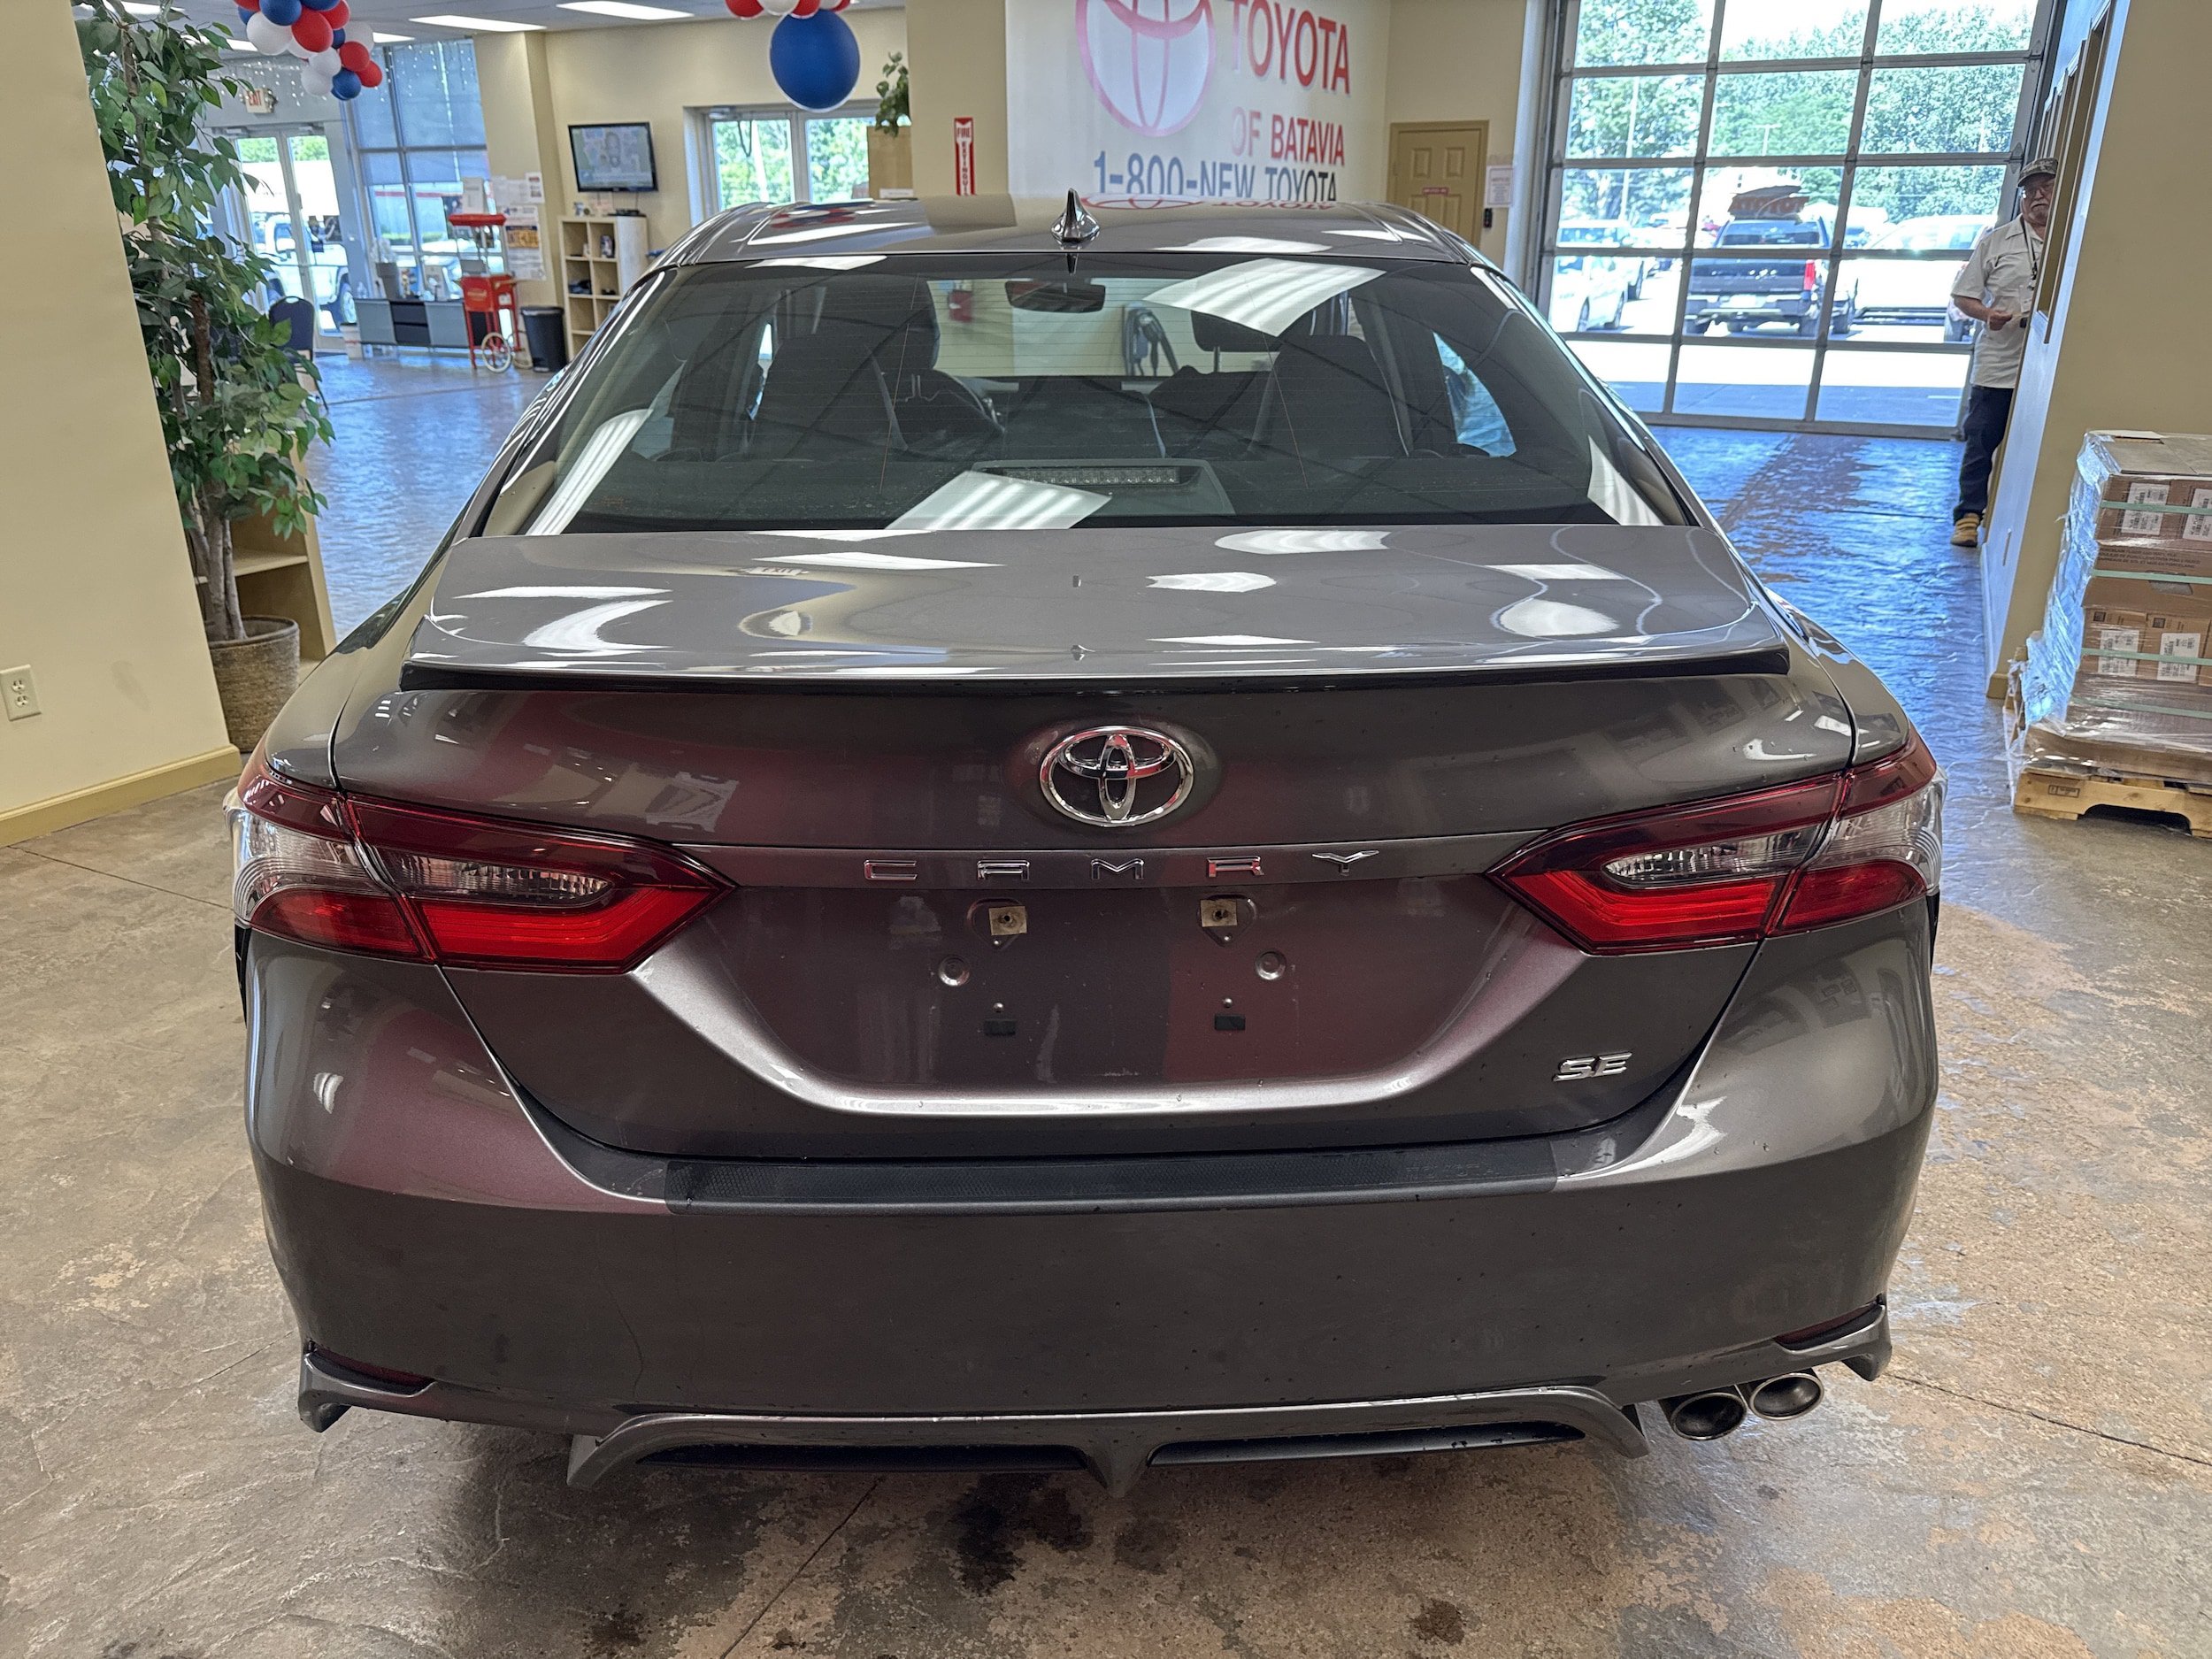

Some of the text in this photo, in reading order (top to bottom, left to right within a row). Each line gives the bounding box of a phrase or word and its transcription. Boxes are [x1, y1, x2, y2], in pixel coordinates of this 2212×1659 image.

[1231, 0, 1350, 95] TOYOTA
[956, 127, 971, 138] FIRE
[1232, 105, 1346, 166] OF BATAVIA
[1264, 166, 1337, 202] TOYOTA
[863, 849, 1380, 881] CAMRY
[1552, 1051, 1632, 1082] SE
